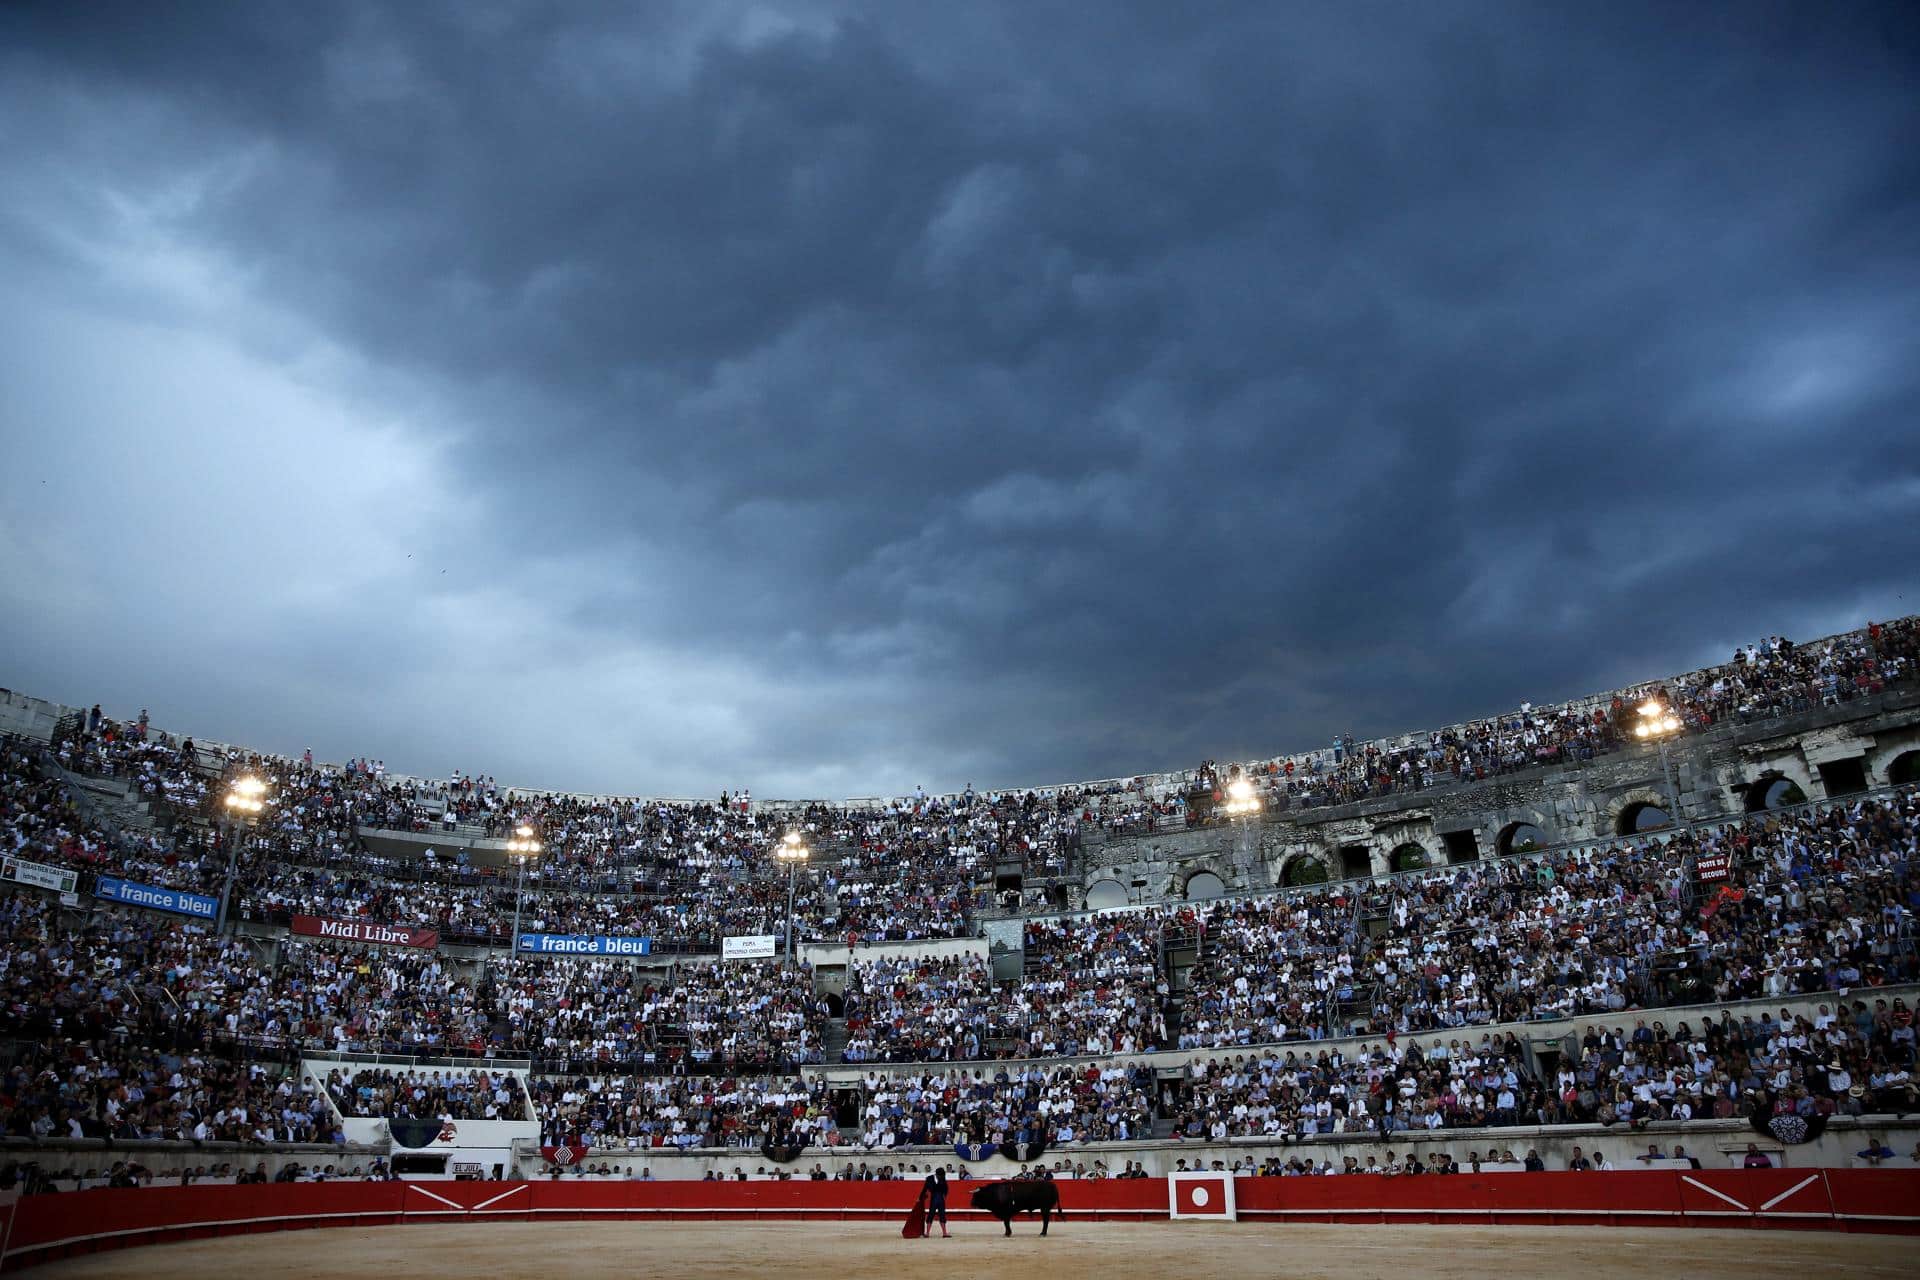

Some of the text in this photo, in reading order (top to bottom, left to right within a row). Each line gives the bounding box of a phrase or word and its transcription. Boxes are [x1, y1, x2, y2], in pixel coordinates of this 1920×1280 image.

[1698, 860, 1716, 869] POSTE
[1701, 869, 1727, 879] SECOURS
[121, 884, 173, 907] france
[178, 895, 212, 914] bleu
[320, 920, 409, 943] Midi Libre
[542, 936, 598, 952] france
[605, 938, 643, 953] bleu
